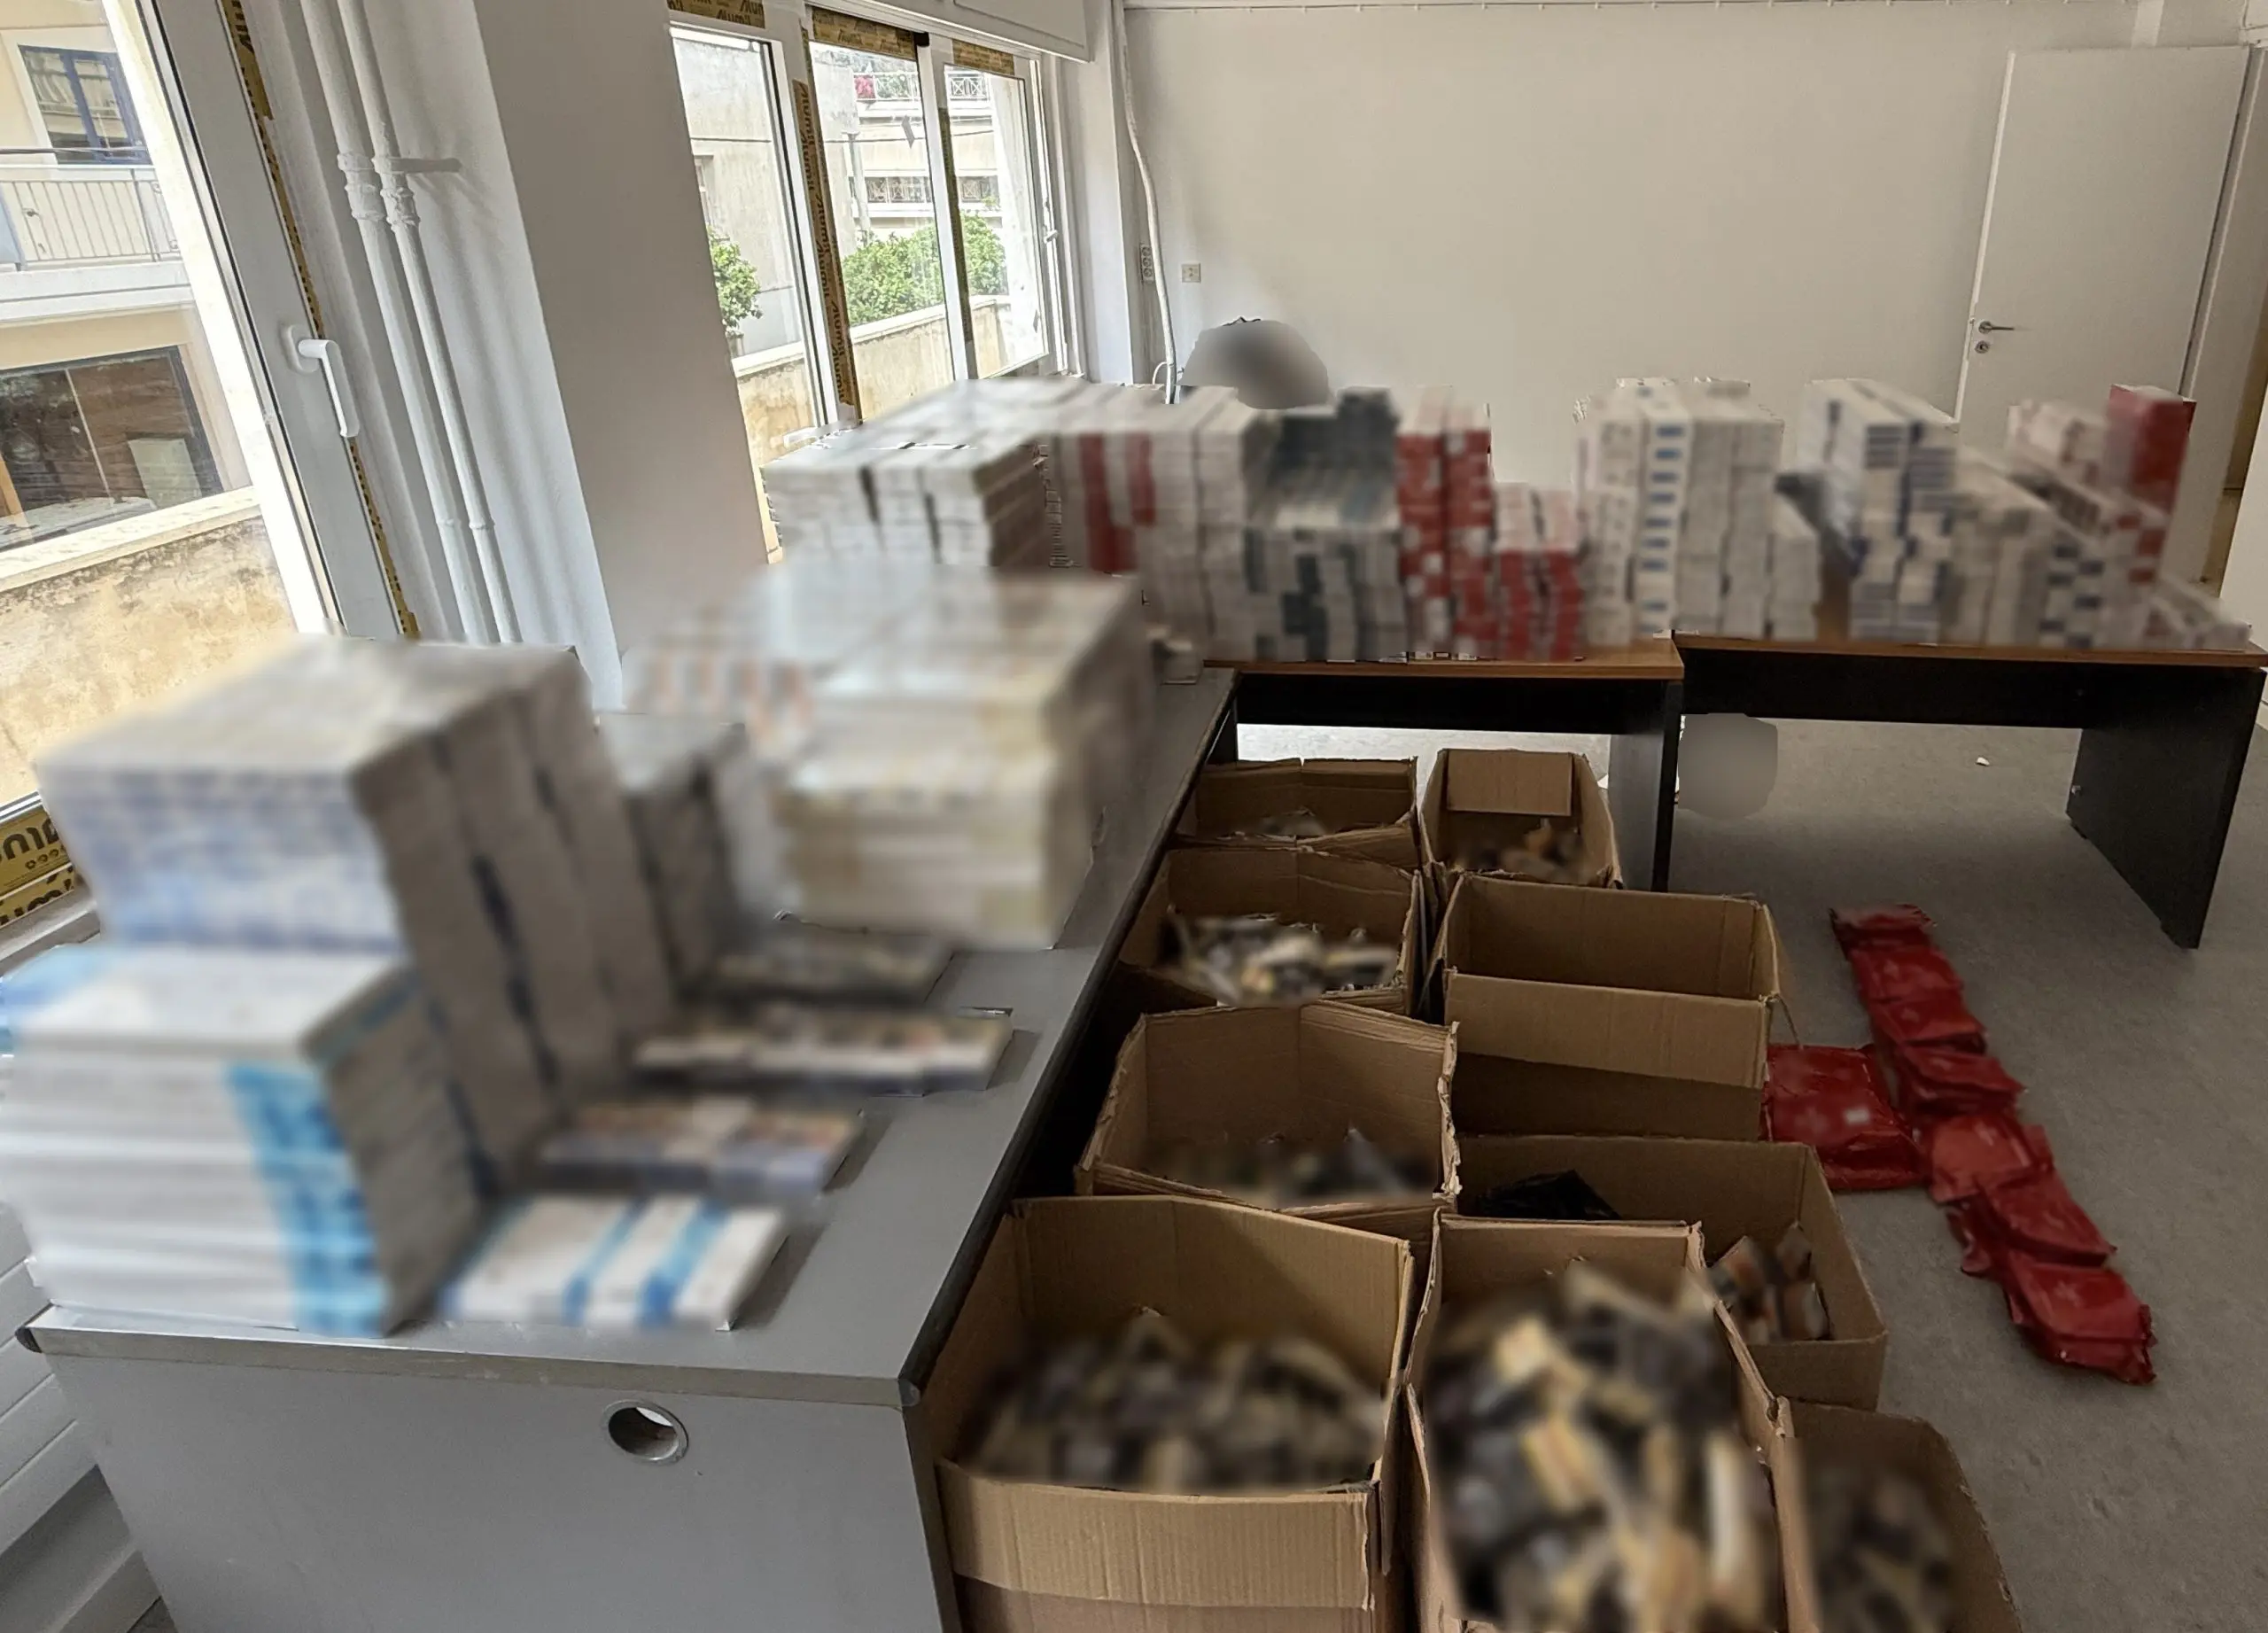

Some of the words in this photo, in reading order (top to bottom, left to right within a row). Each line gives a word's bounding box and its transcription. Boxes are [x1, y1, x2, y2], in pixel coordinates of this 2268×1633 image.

[815, 194, 831, 253] Alumil
[816, 240, 830, 297] Alumil
[832, 300, 845, 356] Alumil
